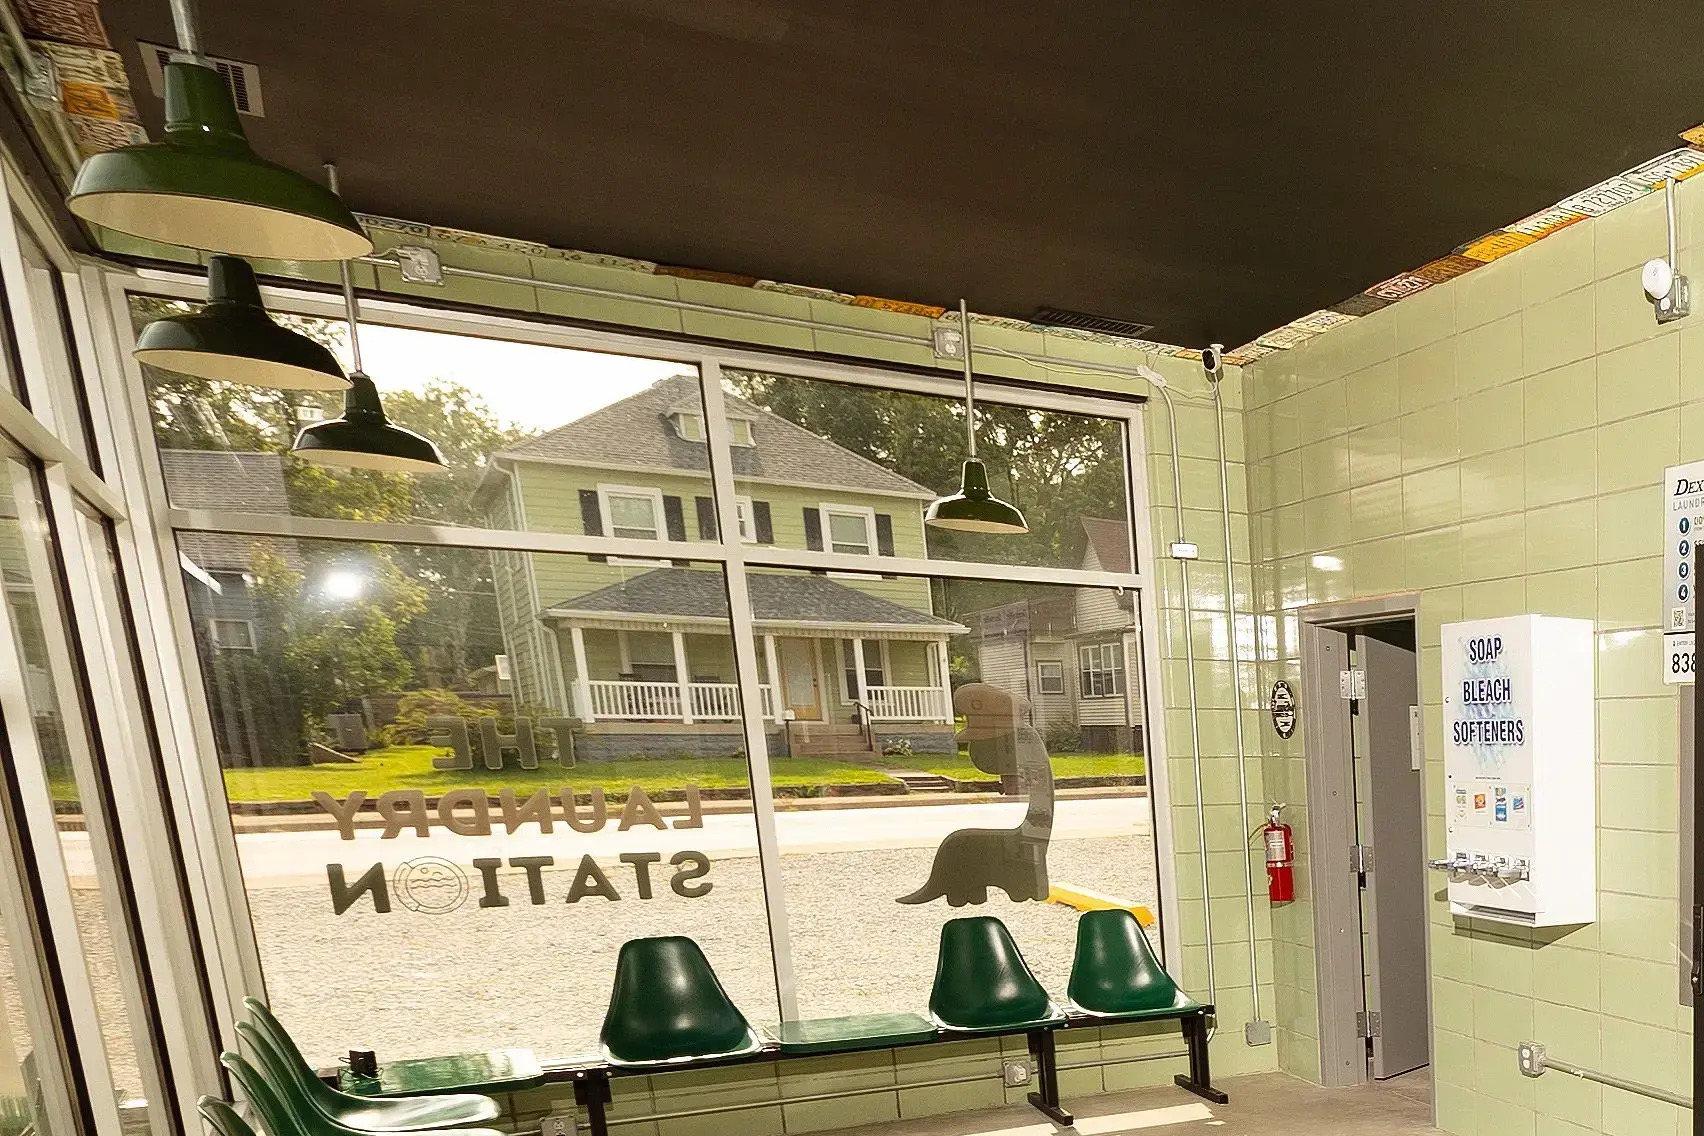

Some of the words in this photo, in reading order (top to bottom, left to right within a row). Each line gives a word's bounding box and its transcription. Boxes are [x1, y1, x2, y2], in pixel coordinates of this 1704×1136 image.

[1469, 636, 1502, 662] SOAP
[1463, 678, 1511, 702] BLEACH
[1453, 720, 1524, 744] SOFTENERS
